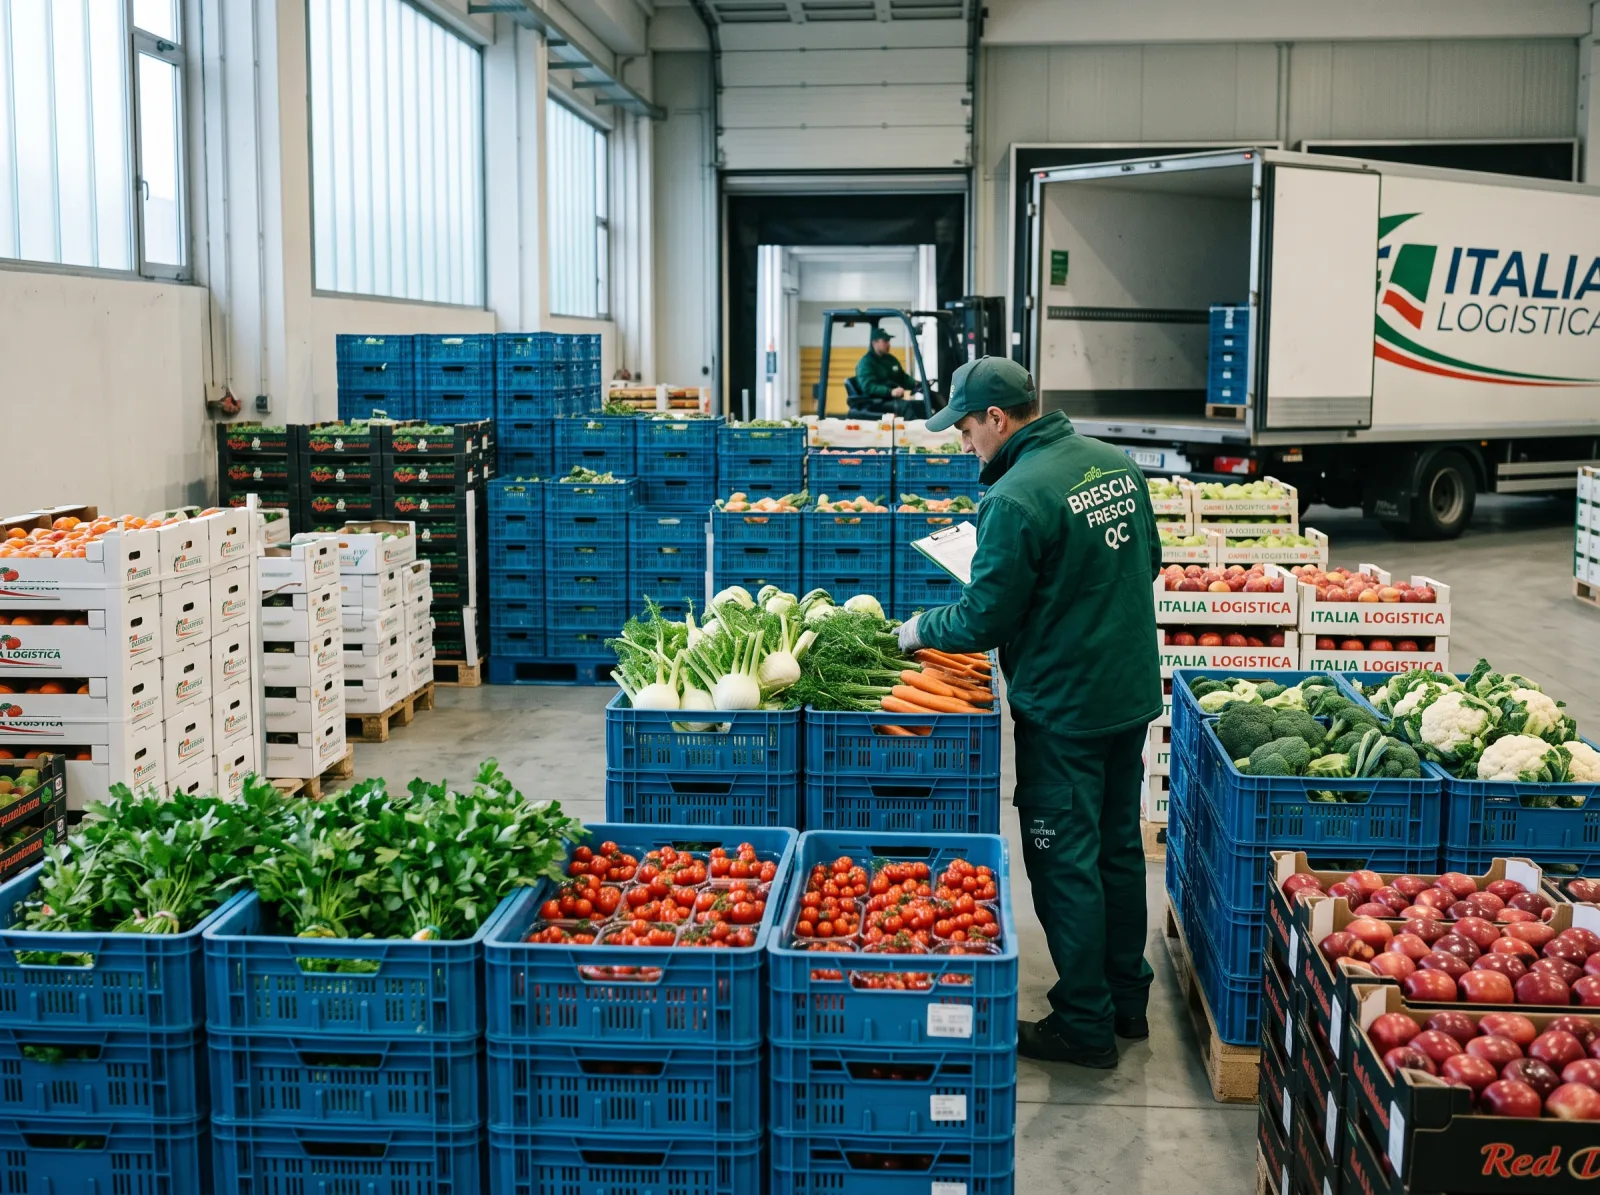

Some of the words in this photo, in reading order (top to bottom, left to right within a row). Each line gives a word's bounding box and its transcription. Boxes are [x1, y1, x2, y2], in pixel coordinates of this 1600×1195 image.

[1444, 247, 1600, 300] ITALIA
[1067, 475, 1138, 514] BRESCIA
[1086, 498, 1136, 528] FRESCO
[1104, 522, 1130, 550] QC
[1158, 600, 1207, 613] ITALIA
[1211, 601, 1291, 613] LOGISTICA
[1311, 611, 1360, 623] ITALIA
[1364, 612, 1445, 624] LOGISTICA
[7, 650, 61, 659] LOGISTICA
[1160, 655, 1207, 667] ITALIA
[1212, 656, 1291, 667] LOGISTICA
[1310, 659, 1359, 671] ITALIA
[1364, 660, 1443, 672] LOGISTICA
[1035, 837, 1050, 850] QC
[1481, 1142, 1561, 1178] Red
